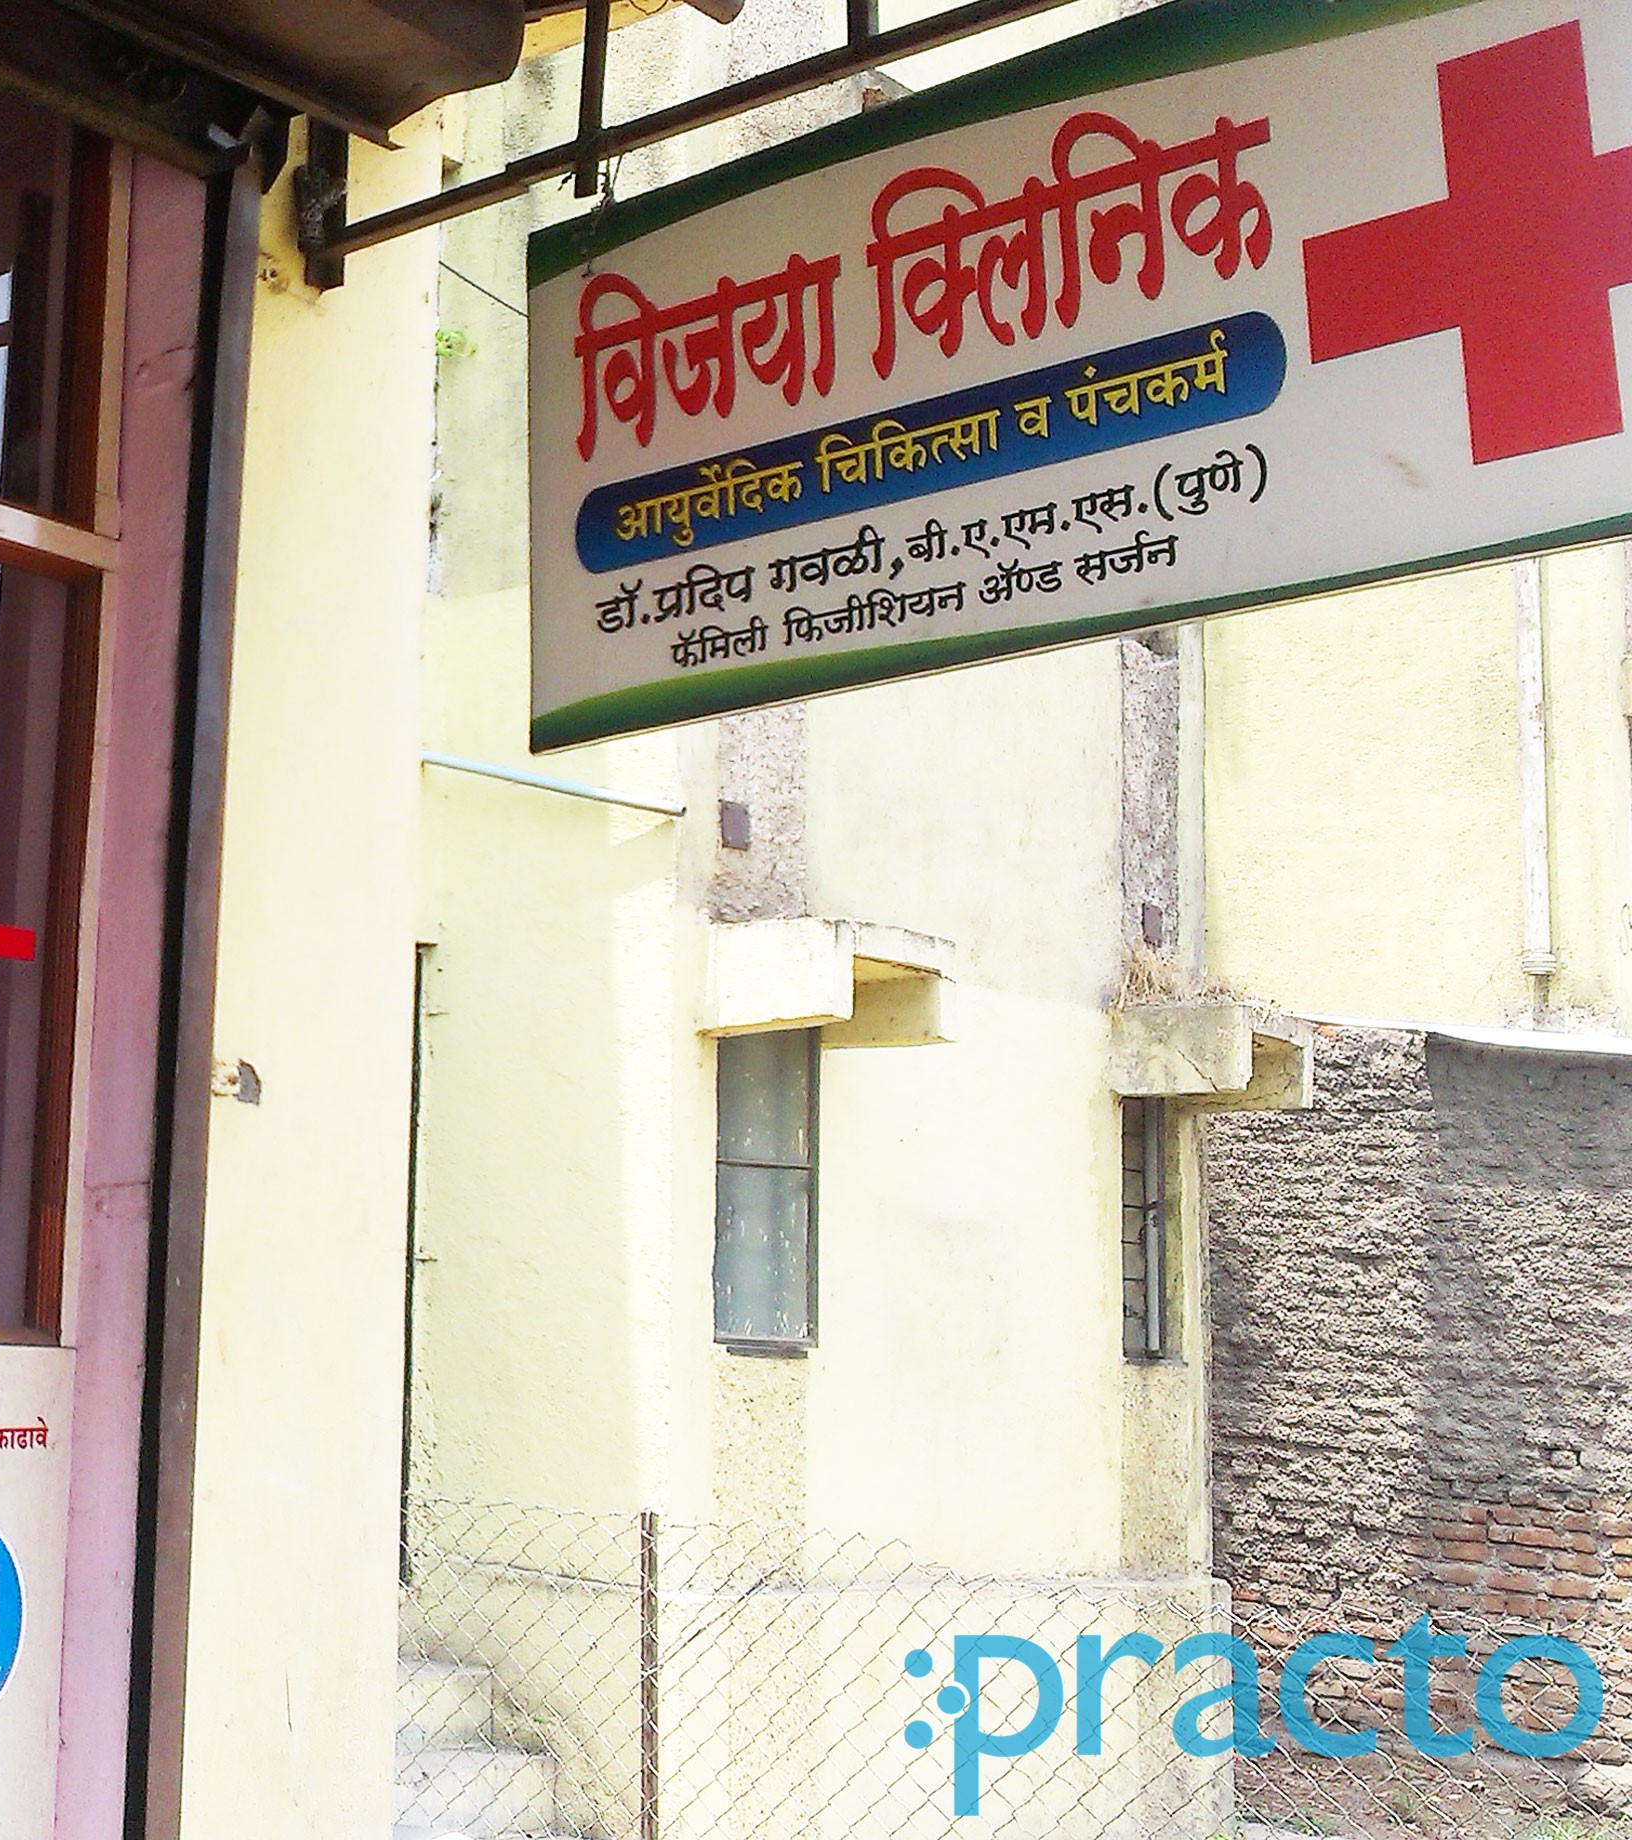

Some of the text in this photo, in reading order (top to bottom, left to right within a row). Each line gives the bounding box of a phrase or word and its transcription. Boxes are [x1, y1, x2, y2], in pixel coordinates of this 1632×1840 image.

[574, 111, 1272, 463] विजया क्लिनिक
[614, 327, 1229, 547] आयुर्वेदिक चिकित्सा व पंचकर्म
[783, 579, 968, 647] फिजीशियन
[1073, 529, 1179, 585] सर्जन
